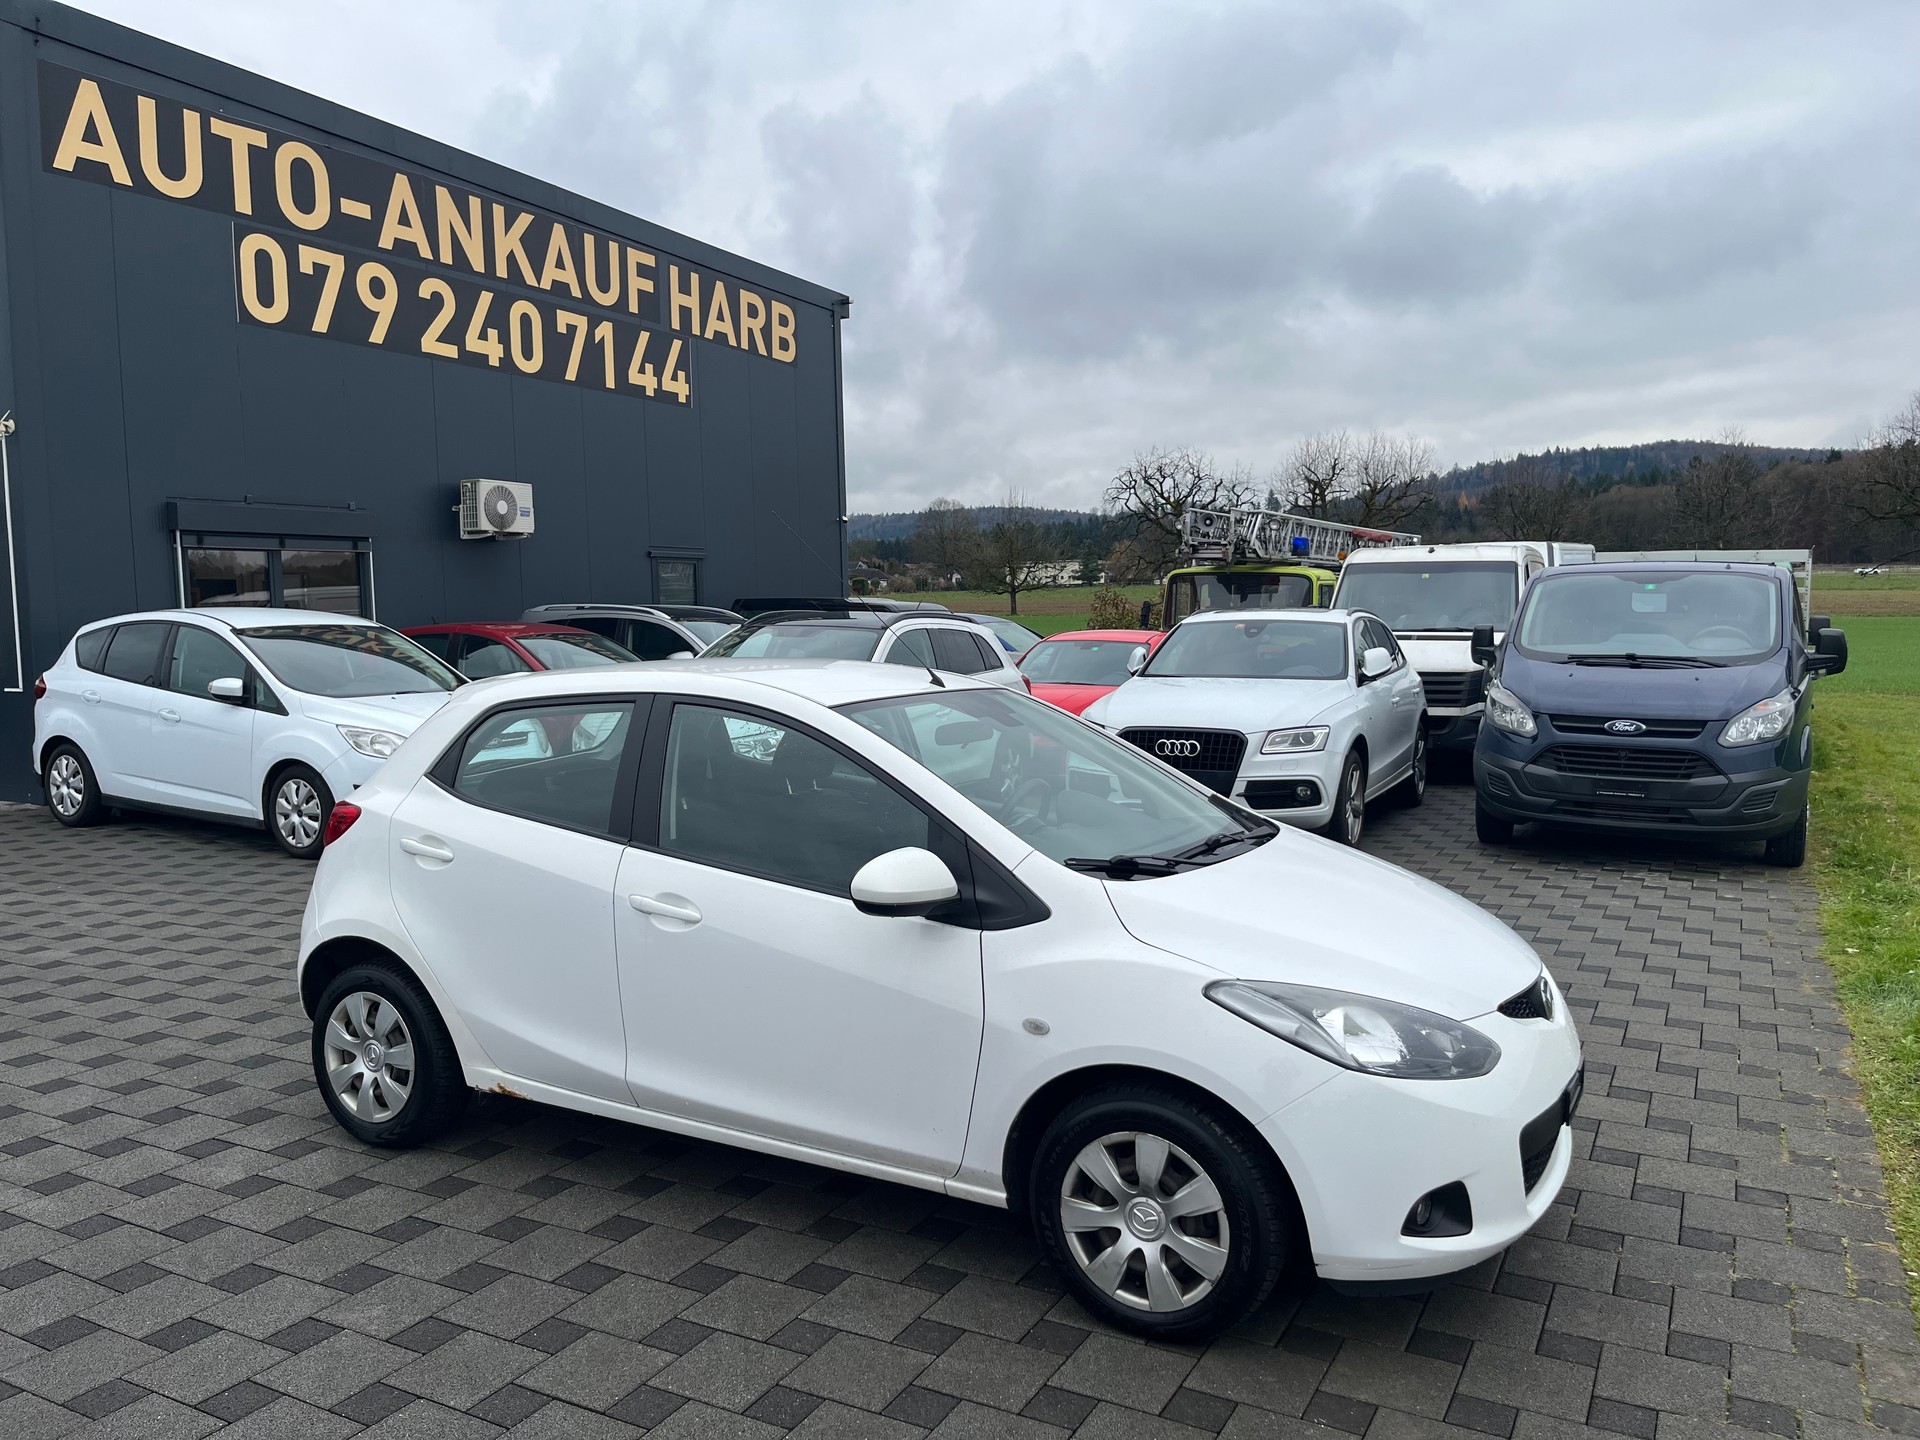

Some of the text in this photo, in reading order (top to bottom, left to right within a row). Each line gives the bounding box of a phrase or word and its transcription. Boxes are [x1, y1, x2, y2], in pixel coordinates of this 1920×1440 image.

[53, 79, 797, 363] AUTO-ANKAUF HARB
[240, 233, 398, 344] 079
[419, 277, 545, 374] 240
[1612, 721, 1636, 731] Ford
